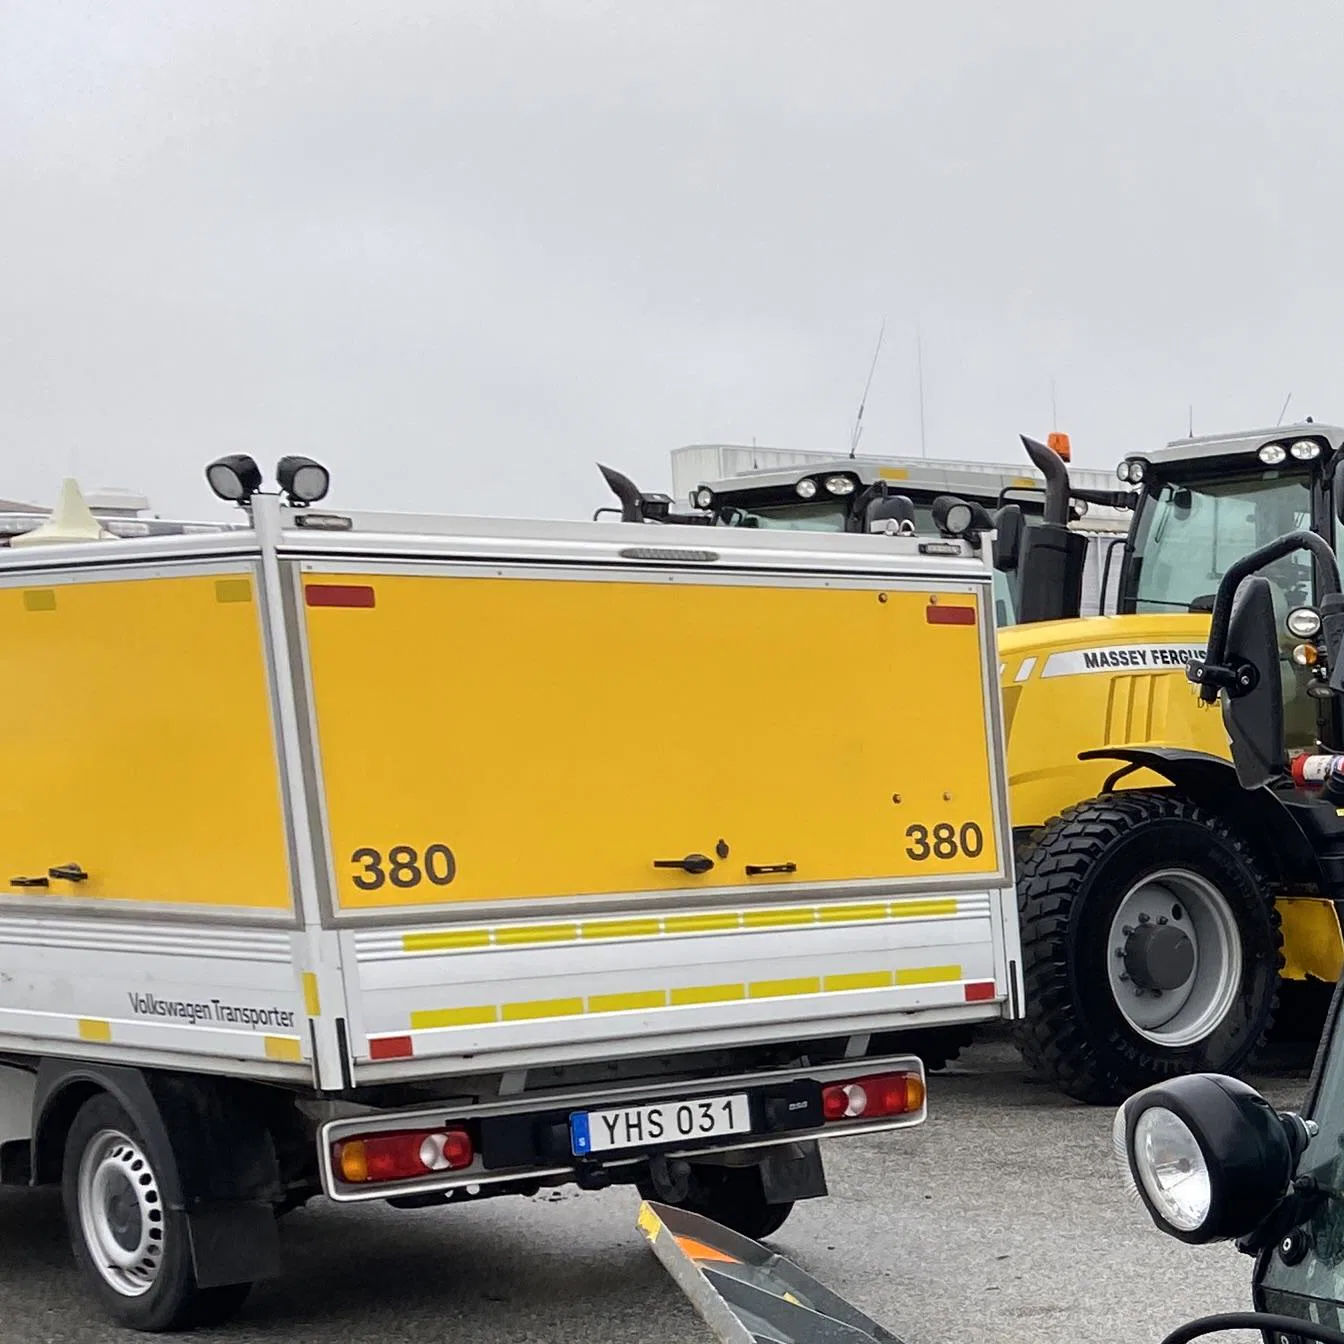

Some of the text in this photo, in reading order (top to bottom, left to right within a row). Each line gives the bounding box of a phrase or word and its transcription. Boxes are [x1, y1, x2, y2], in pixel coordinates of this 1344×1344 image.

[1084, 650, 1149, 669] MASSEY
[904, 821, 984, 862] 380
[350, 843, 457, 891] 380
[128, 992, 294, 1030] Volkswagen Transporter
[601, 1100, 736, 1145] YHS 031
